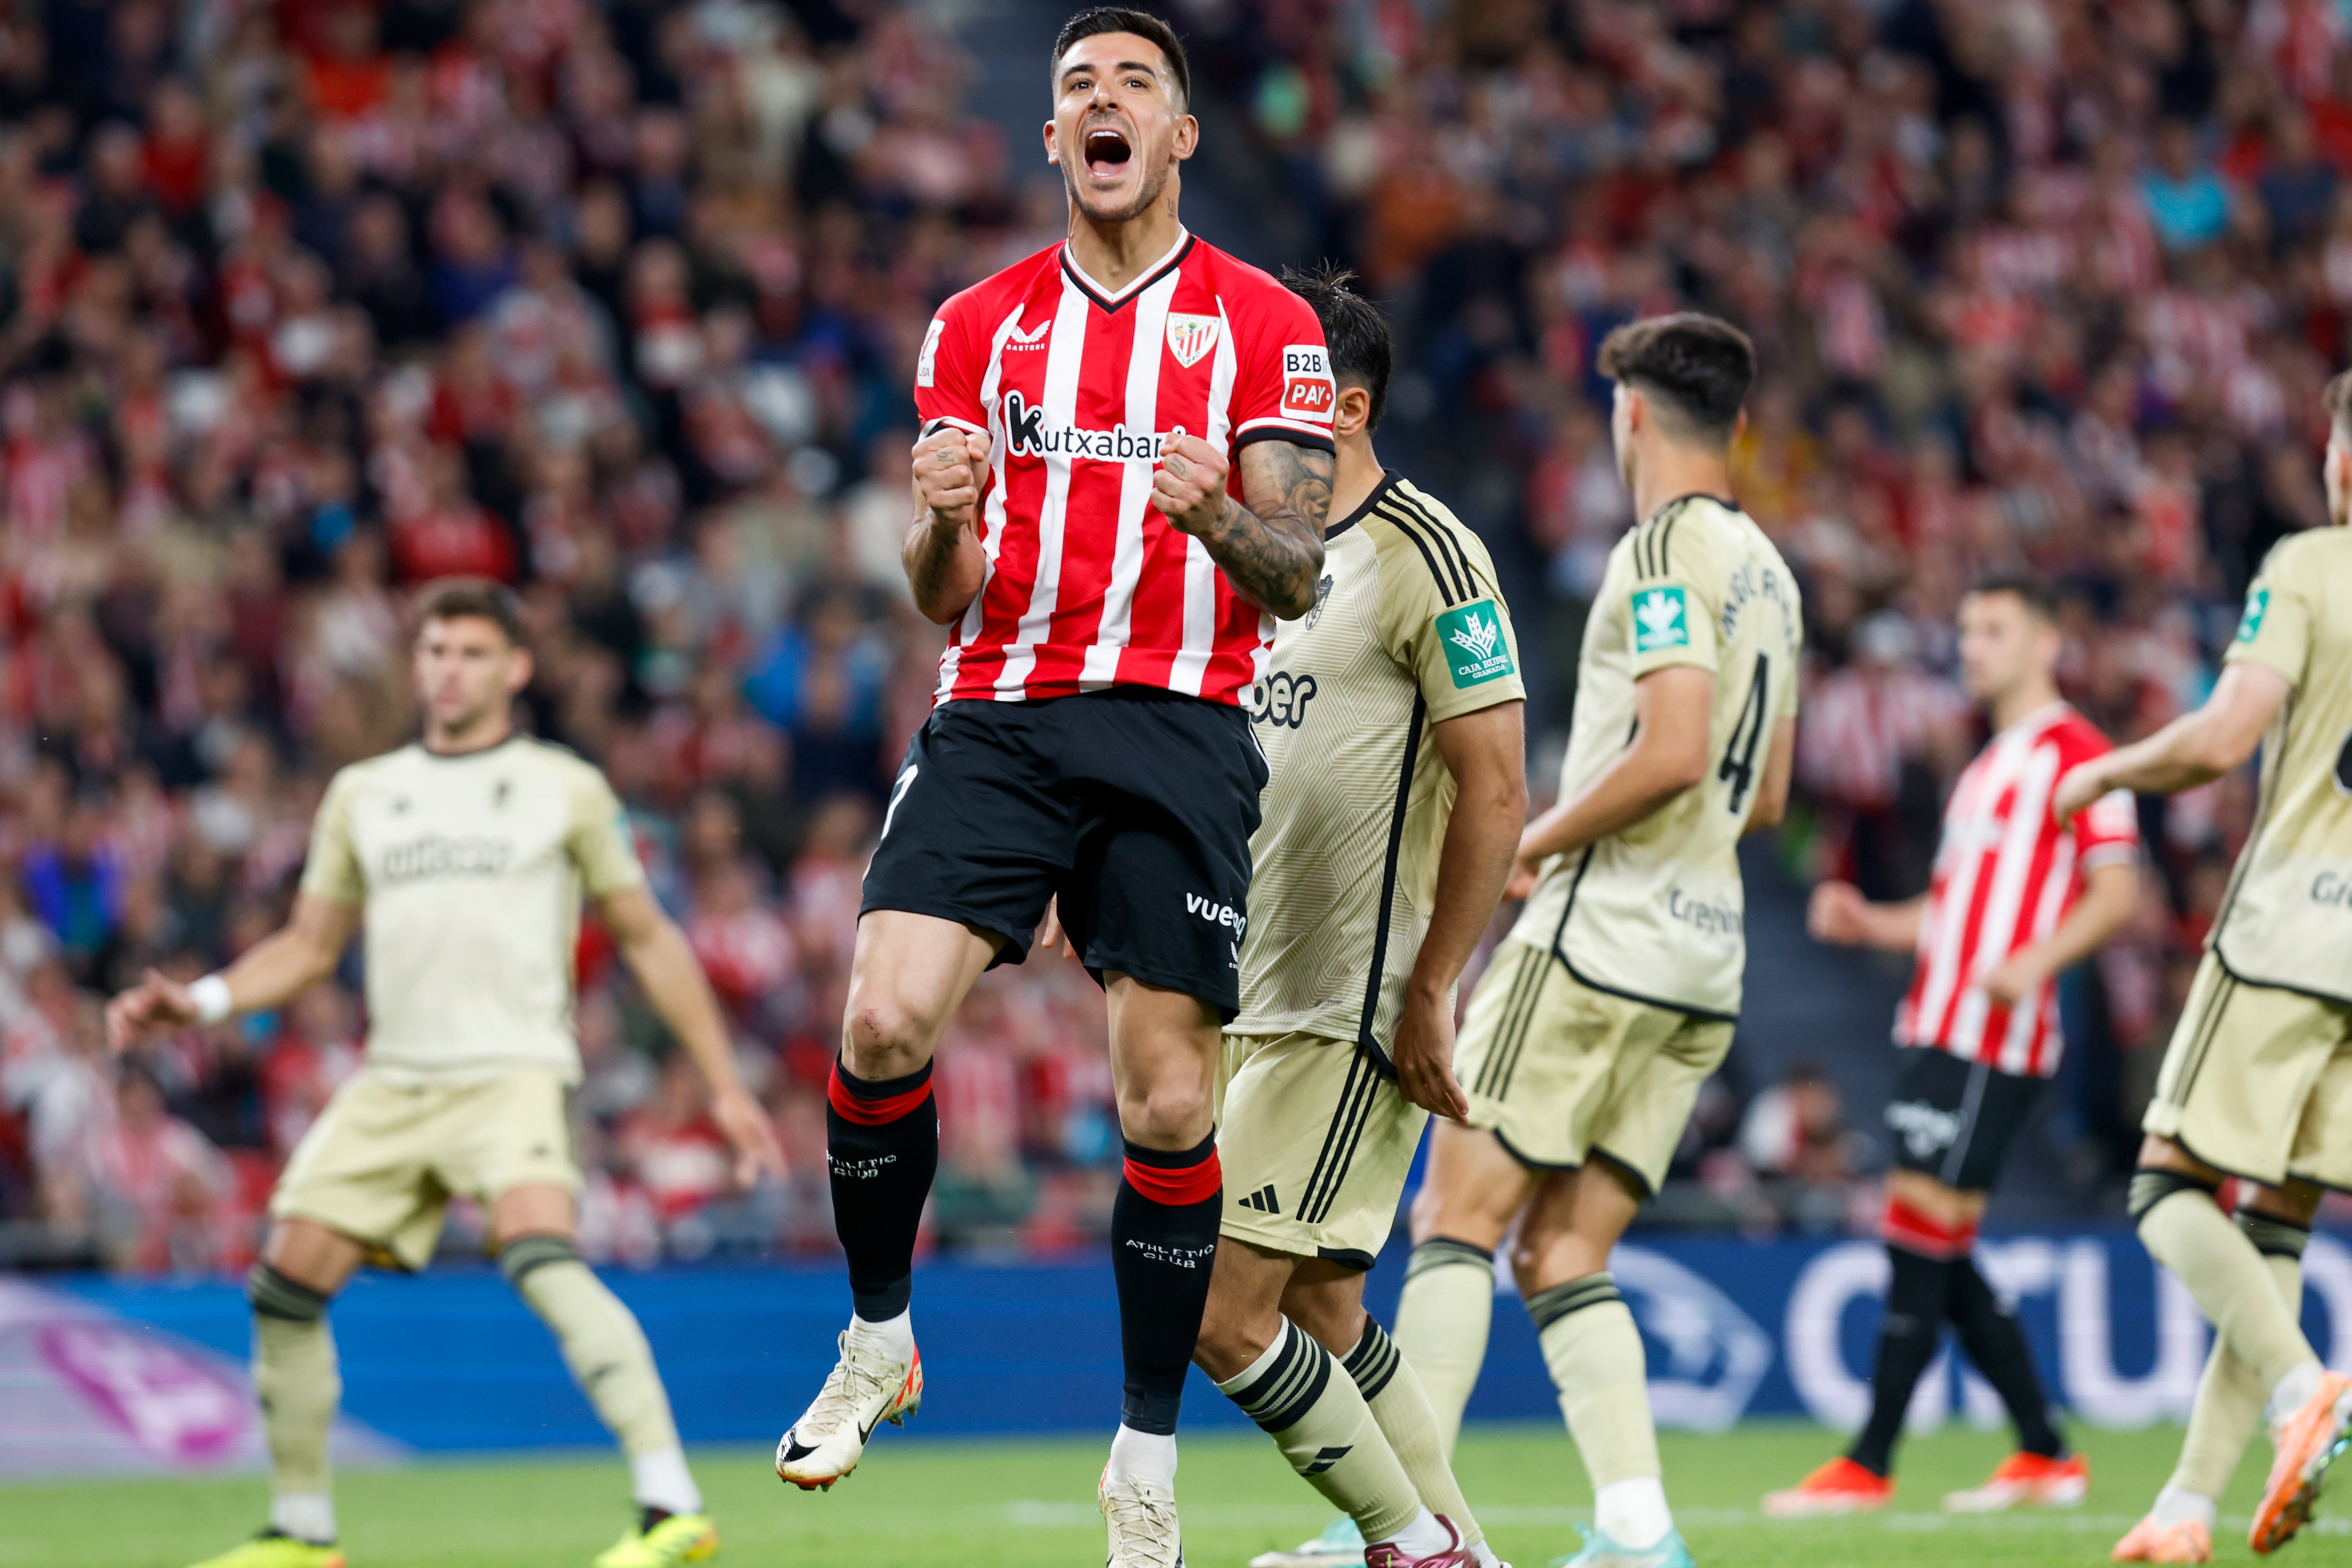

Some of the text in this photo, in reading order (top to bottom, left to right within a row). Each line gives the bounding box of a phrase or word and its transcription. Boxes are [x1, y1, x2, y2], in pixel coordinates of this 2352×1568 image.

[1006, 342, 1045, 352] CASTORE
[1177, 350, 1200, 365] BILBAO
[1291, 384, 1326, 406] PAY
[1009, 395, 1181, 459] Kutxaba
[1458, 663, 1483, 676] CAJA
[1472, 664, 1505, 679] GRANADA
[1718, 650, 1768, 814] 4
[1126, 1239, 1215, 1259] ATHLETIC
